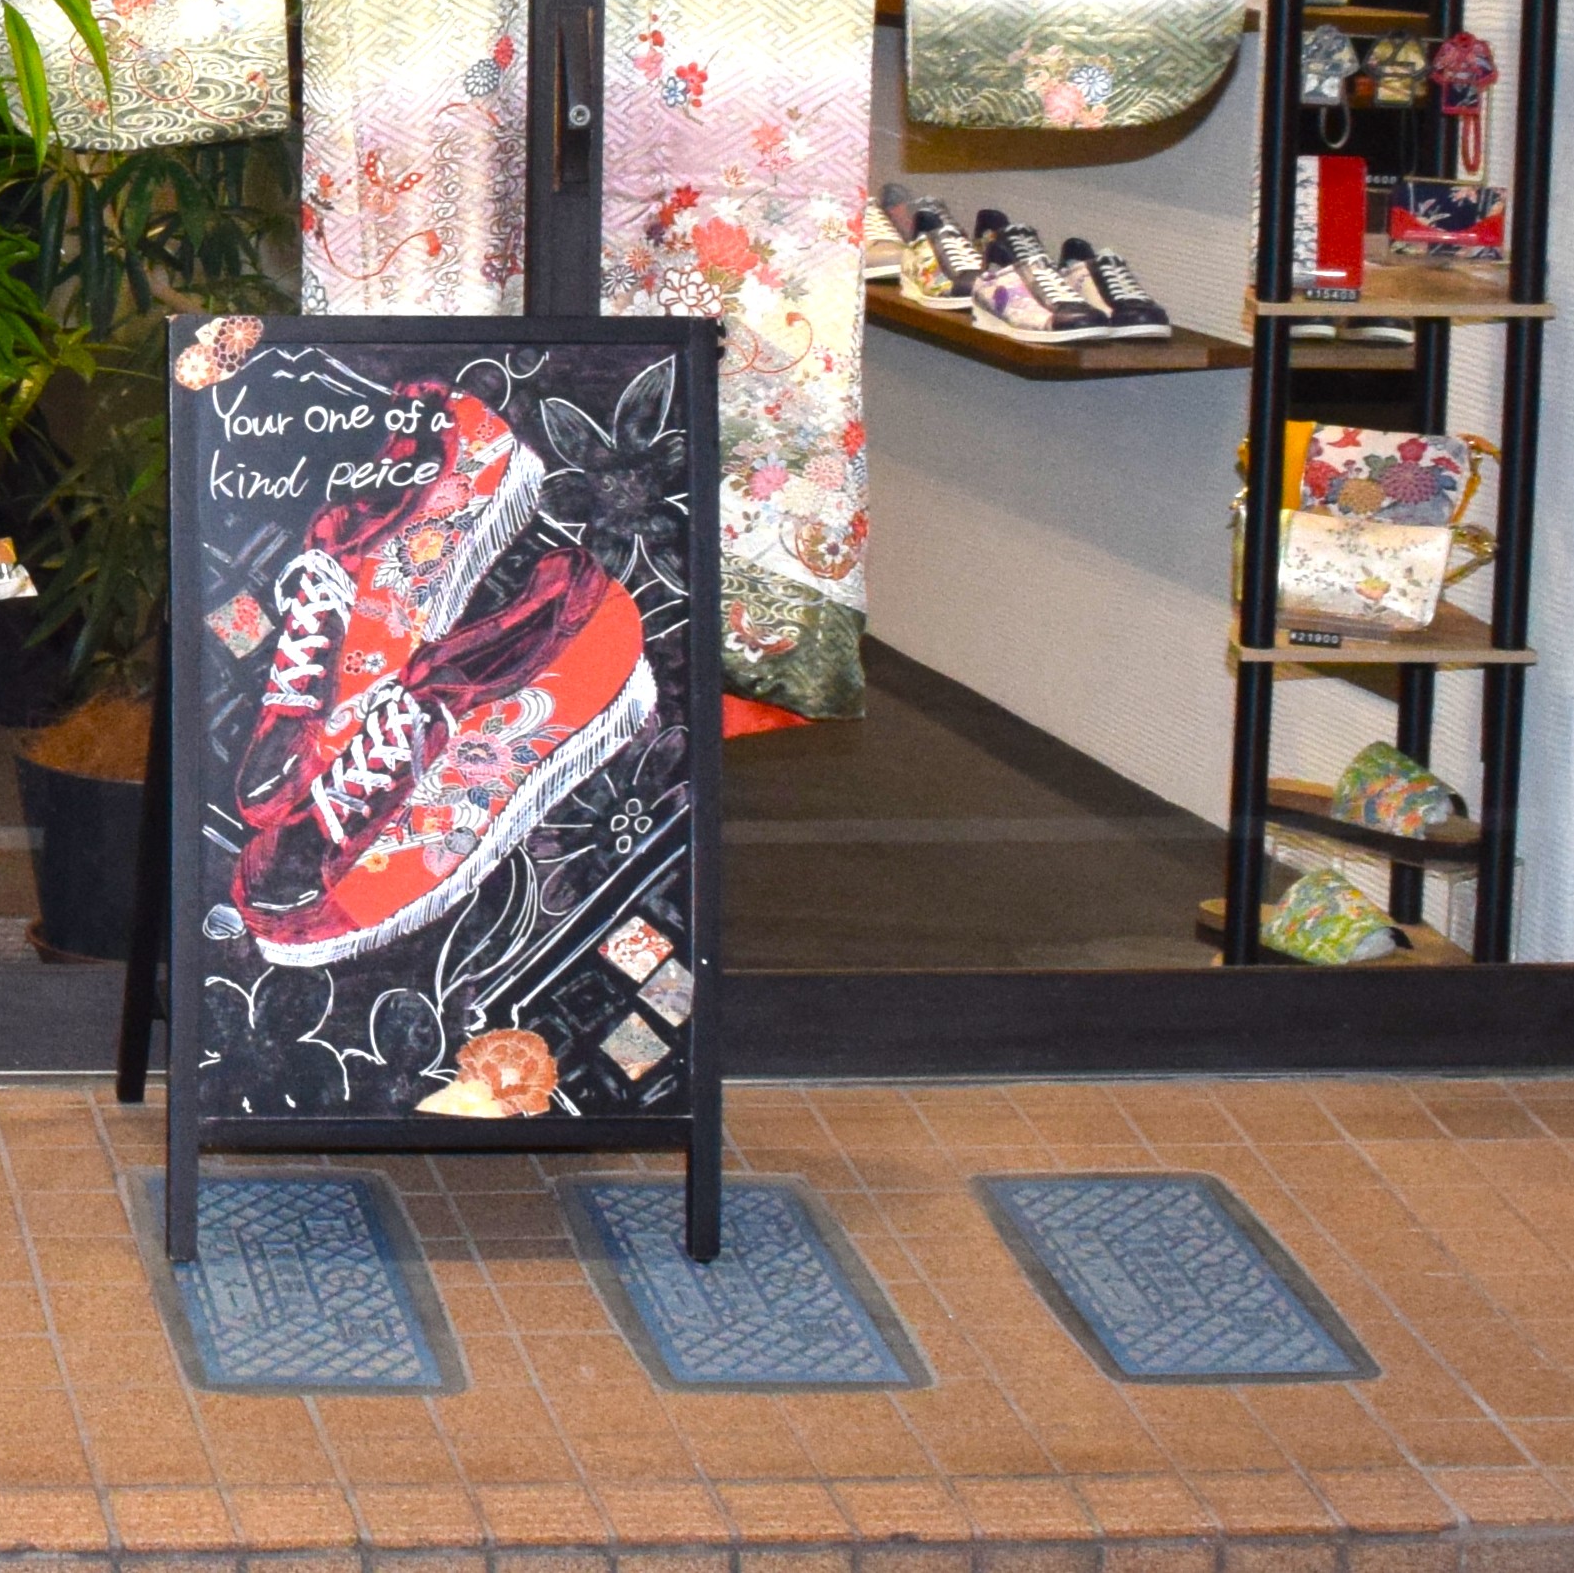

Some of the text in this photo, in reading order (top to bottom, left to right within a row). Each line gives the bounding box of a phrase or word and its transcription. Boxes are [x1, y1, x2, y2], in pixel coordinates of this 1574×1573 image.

[212, 385, 293, 442] Your
[385, 399, 424, 433] of
[431, 412, 455, 433] a
[210, 449, 439, 501] kind peice
